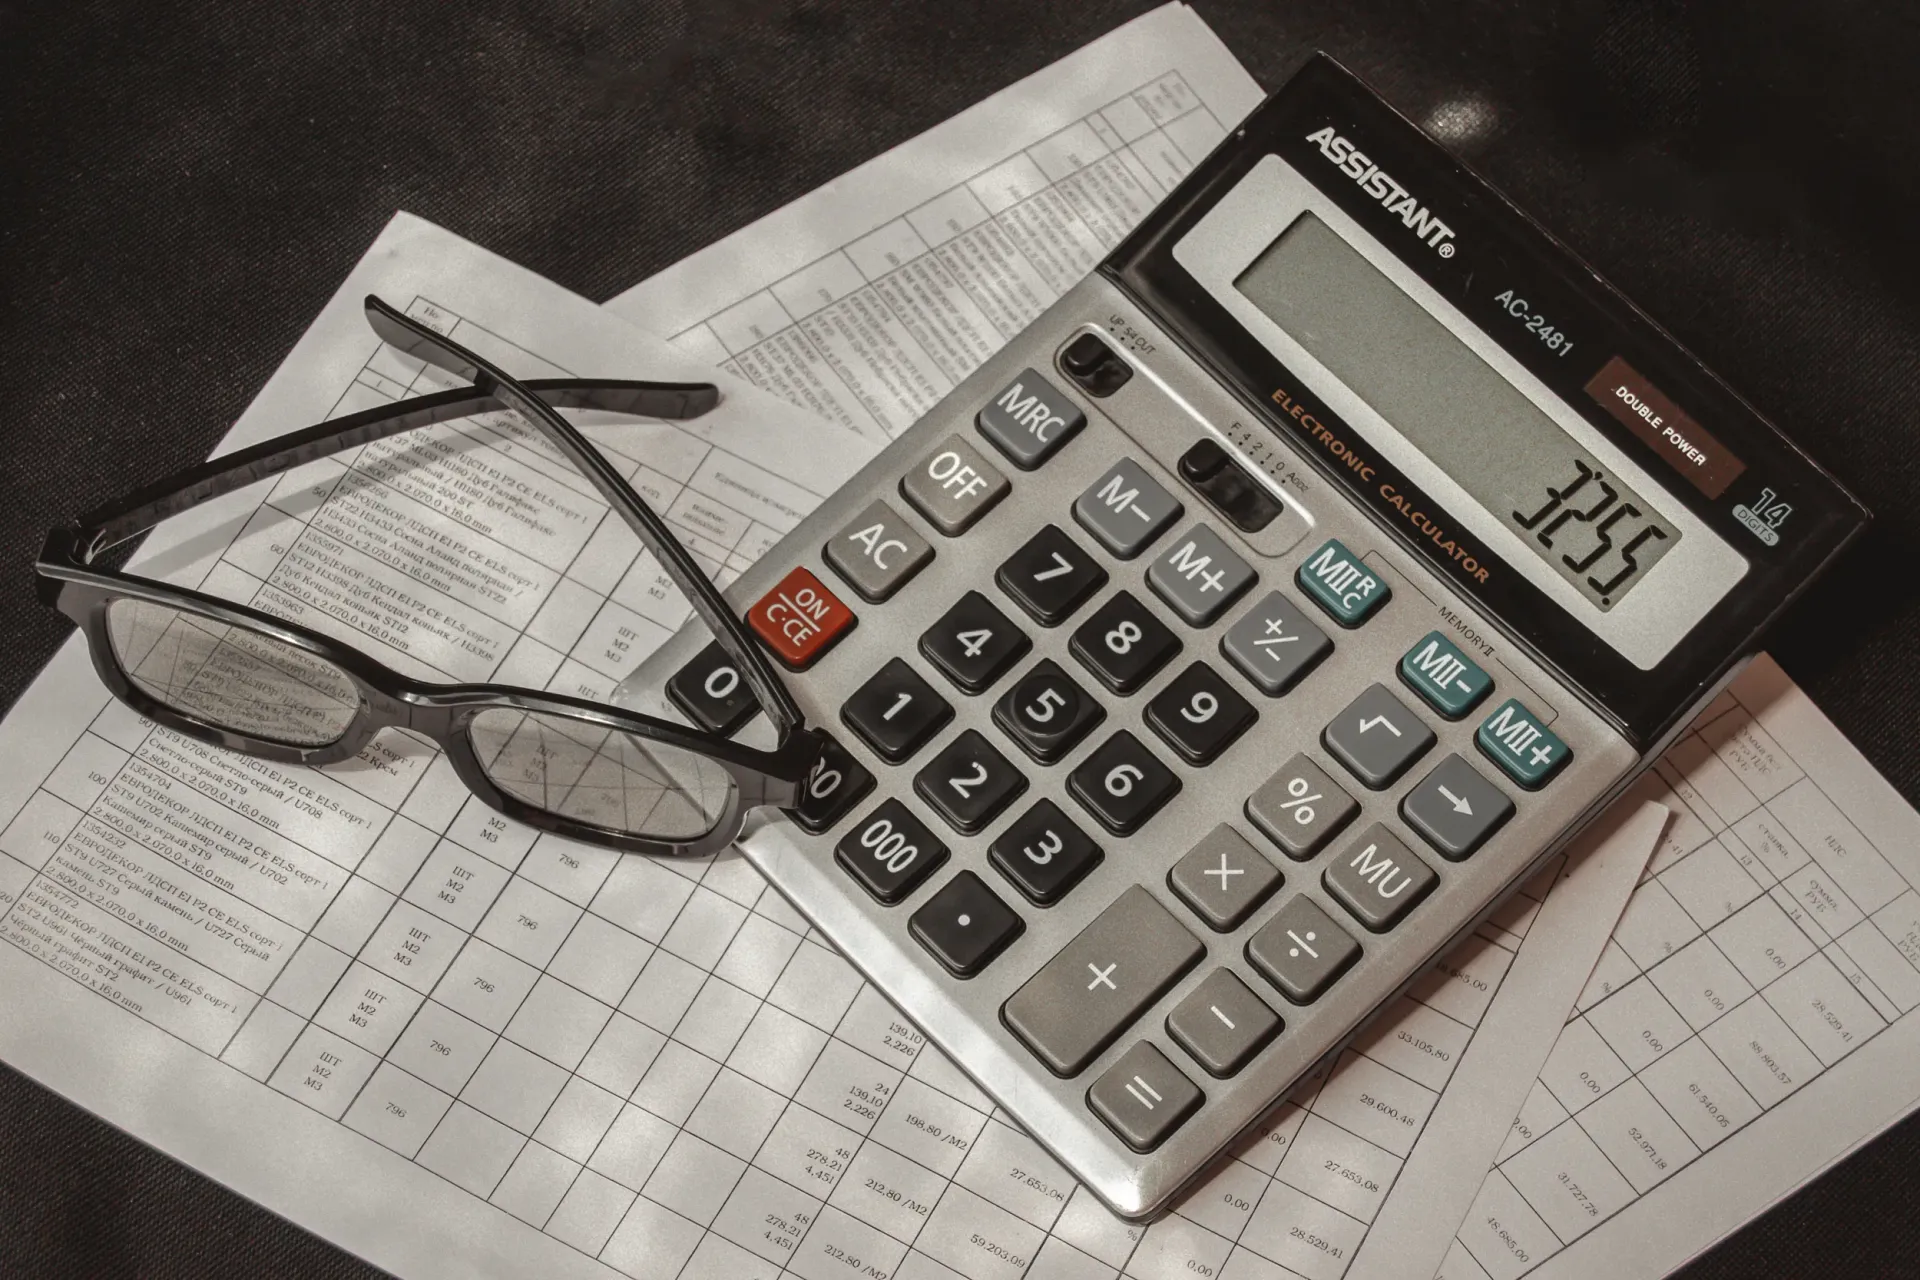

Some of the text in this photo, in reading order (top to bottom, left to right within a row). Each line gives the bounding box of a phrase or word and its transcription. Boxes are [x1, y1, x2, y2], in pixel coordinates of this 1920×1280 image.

[1110, 314, 1125, 326] UP
[1135, 337, 1156, 354] CUT
[1494, 288, 1574, 358] AC-2481
[997, 384, 1066, 443] MRC
[1614, 384, 1707, 467] DOUBLE POWER
[1253, 442, 1263, 451] 2
[1276, 462, 1285, 470] 0
[311, 485, 326, 497] 50
[927, 450, 988, 500] OFF
[1270, 388, 1490, 586] ELECTRONIC CALCULATOR
[1751, 487, 1792, 529] 14
[1738, 509, 1774, 542] DIGITS
[269, 543, 284, 554] 60
[849, 522, 908, 570] AC
[1034, 552, 1074, 585] 7
[794, 588, 830, 620] ON
[381, 615, 409, 634] ST12
[1105, 621, 1142, 655] 8
[956, 628, 993, 658] 4
[704, 666, 739, 698] 0
[882, 692, 912, 722] 1
[1026, 688, 1066, 723] 5
[1181, 692, 1218, 724] 9
[87, 770, 107, 785] 100
[119, 772, 190, 814] ЕВРОДЕКОР
[949, 760, 988, 799] 2
[1104, 764, 1144, 797] 6
[42, 830, 60, 844] 110
[110, 783, 135, 800] ST9
[134, 796, 163, 817] U702
[214, 843, 249, 865] серый
[258, 864, 288, 885] U702
[153, 826, 188, 848] серый
[187, 843, 212, 860] ST9
[860, 819, 918, 874] 000
[1023, 830, 1063, 864] 3
[558, 852, 580, 869] 796
[1350, 844, 1412, 900] MU
[64, 843, 88, 860] ST9
[88, 856, 117, 876] U727
[116, 873, 153, 898] Серый
[153, 894, 193, 921] камень
[203, 920, 234, 940] U727
[232, 936, 270, 961] Серый
[95, 878, 120, 895] ST9
[516, 914, 538, 930] 796
[473, 976, 495, 993] 796
[429, 1039, 451, 1056] 796
[874, 1082, 889, 1095] 24
[385, 1101, 407, 1118] 796
[834, 1147, 850, 1159] 48
[793, 1212, 810, 1224] 48
